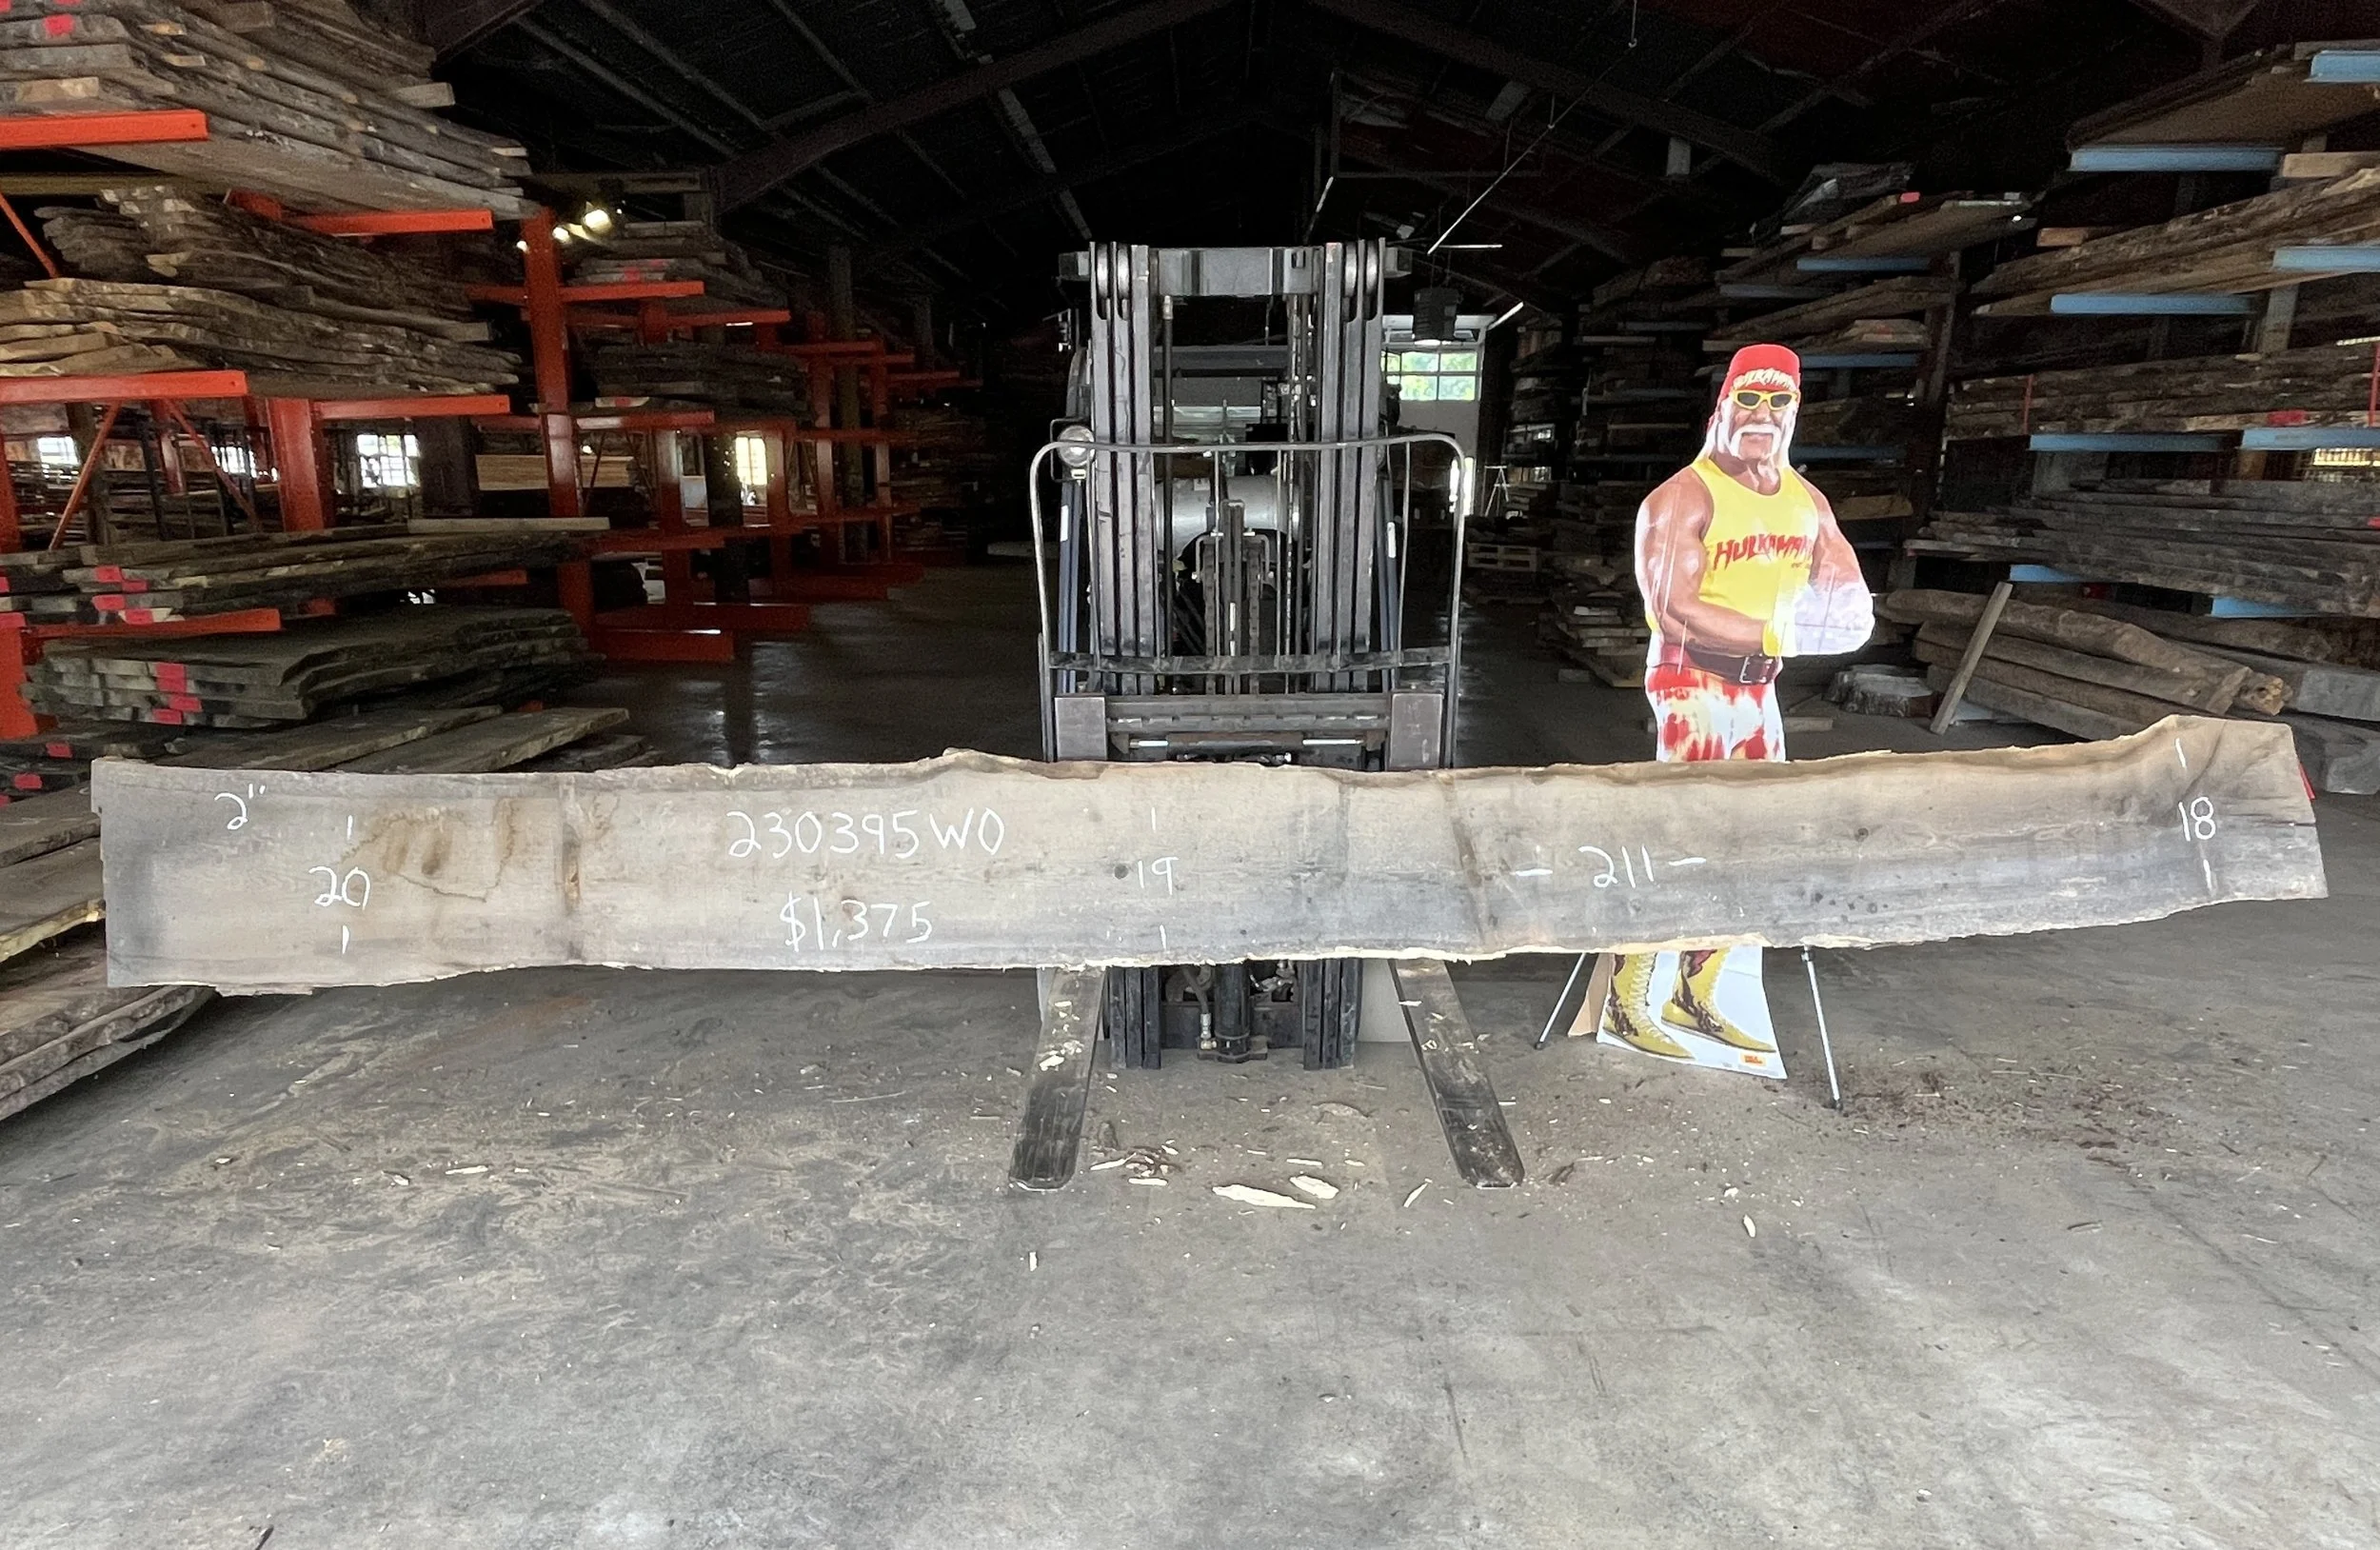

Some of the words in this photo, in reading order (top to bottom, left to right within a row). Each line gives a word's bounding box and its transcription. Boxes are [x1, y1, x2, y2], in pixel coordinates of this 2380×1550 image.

[2176, 796, 2216, 843] 18
[307, 865, 371, 910] 20
[1138, 856, 1180, 896] 19
[1577, 845, 1655, 889] 211
[779, 891, 934, 953] $1,375
